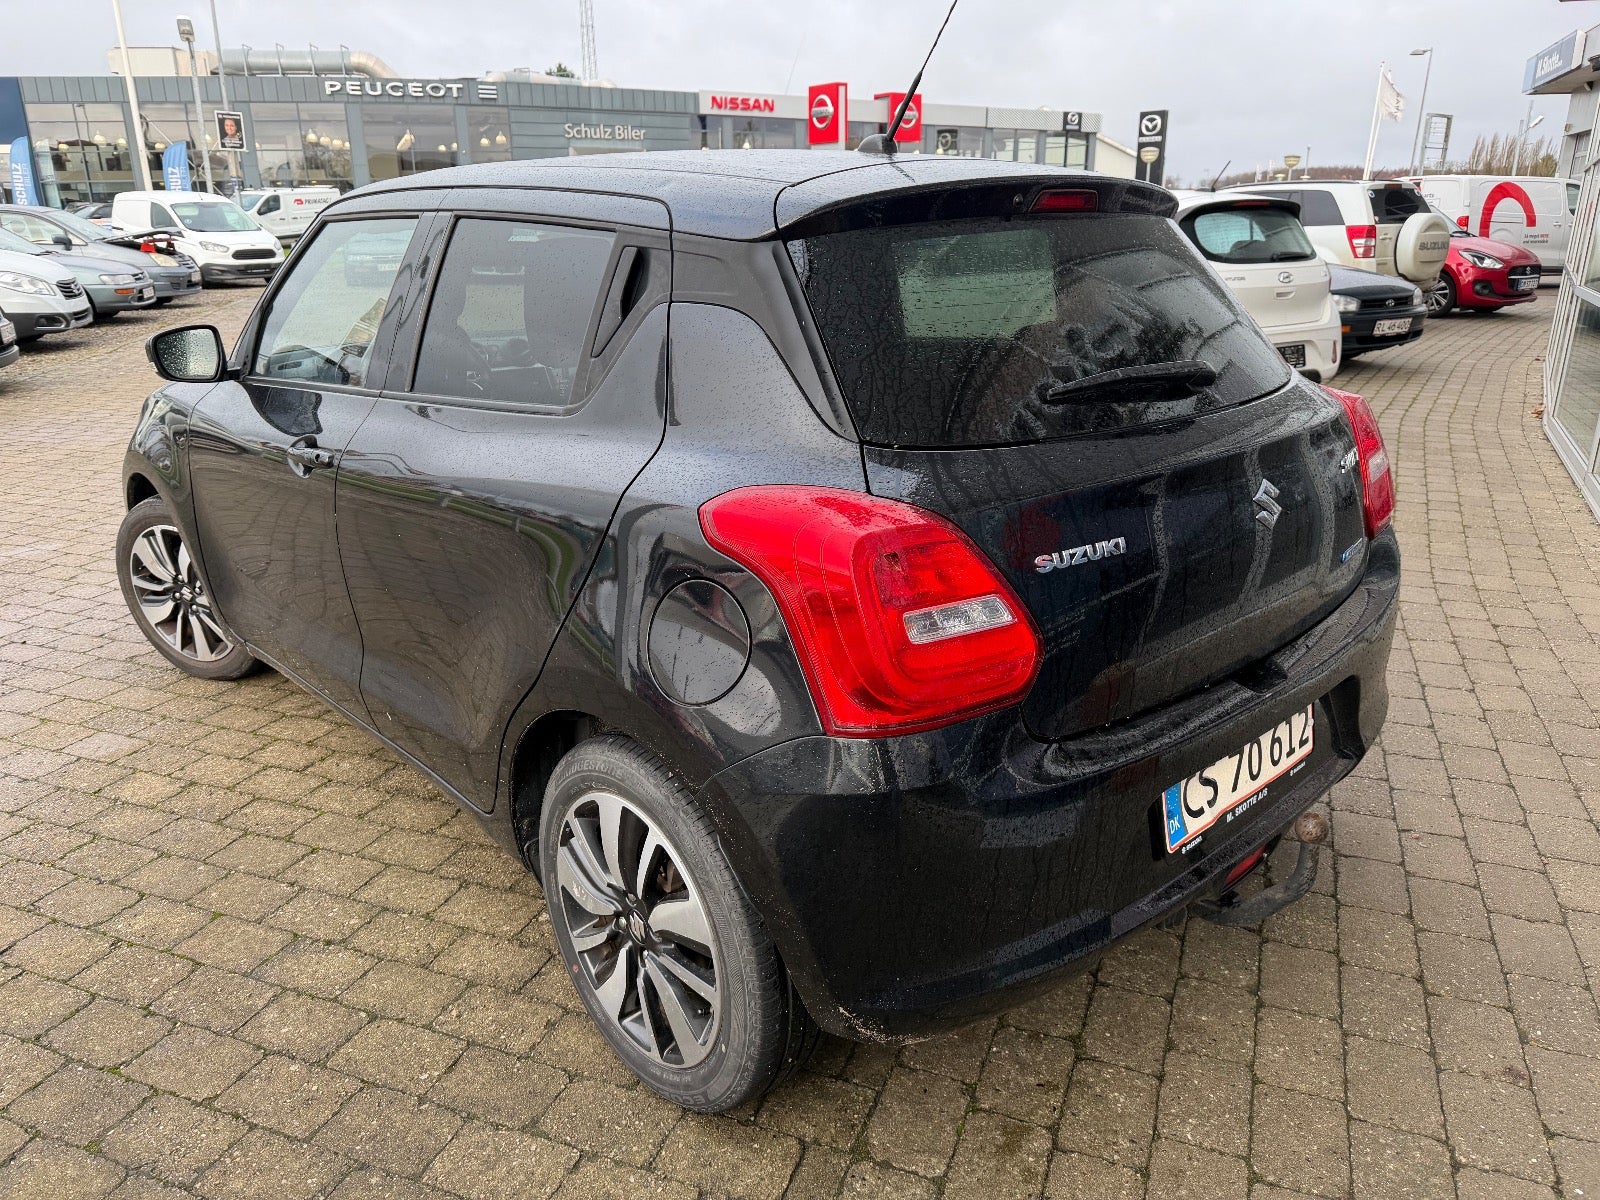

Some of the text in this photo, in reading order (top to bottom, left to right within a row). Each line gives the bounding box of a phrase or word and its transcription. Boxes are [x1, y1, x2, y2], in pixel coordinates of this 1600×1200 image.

[324, 81, 464, 99] PEUGEOT
[711, 95, 775, 112] NISSAN
[564, 123, 646, 140] Schulz Biler
[11, 162, 28, 206] SCHULZ
[1418, 240, 1450, 251] SUZUKI
[1034, 536, 1127, 574] SUZUKI
[1182, 713, 1310, 819] CS 70 612
[1226, 787, 1268, 823] M. SKOTTE A/S
[1169, 815, 1181, 835] DK
